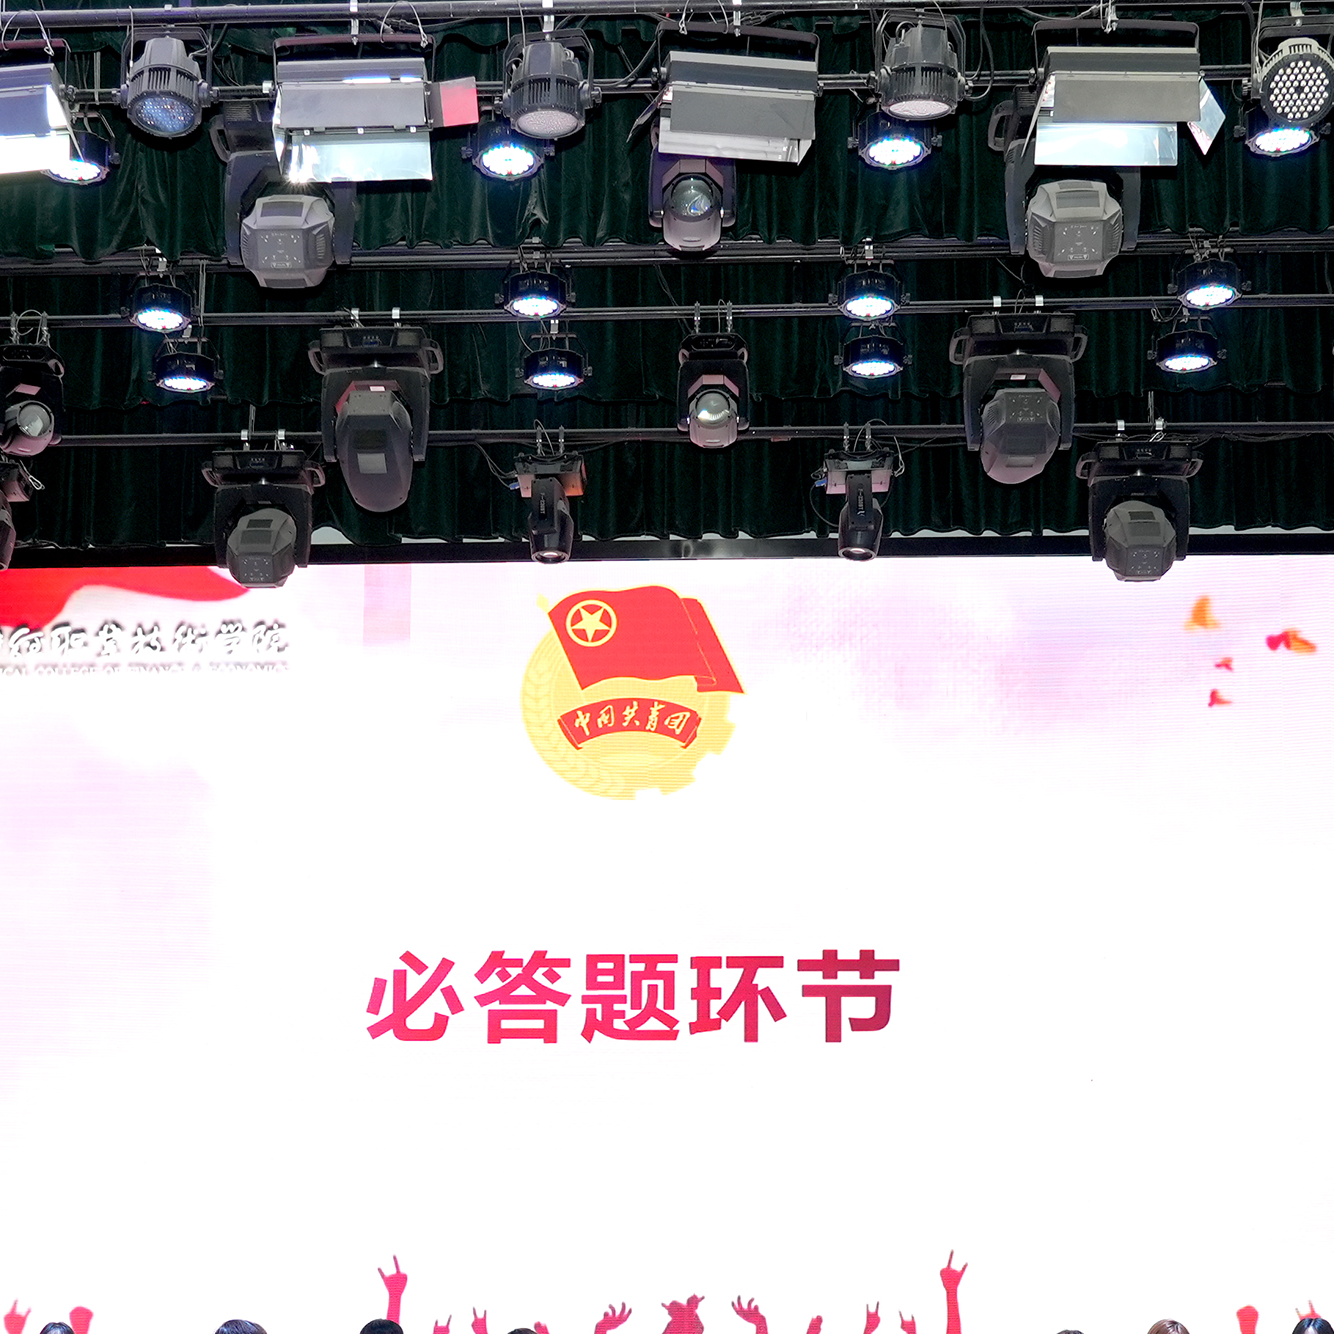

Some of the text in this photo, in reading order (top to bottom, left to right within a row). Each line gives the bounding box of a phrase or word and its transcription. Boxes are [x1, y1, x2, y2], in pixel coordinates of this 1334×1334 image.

[574, 701, 690, 736] 中国共青团
[366, 949, 900, 1044] 必答题环节
